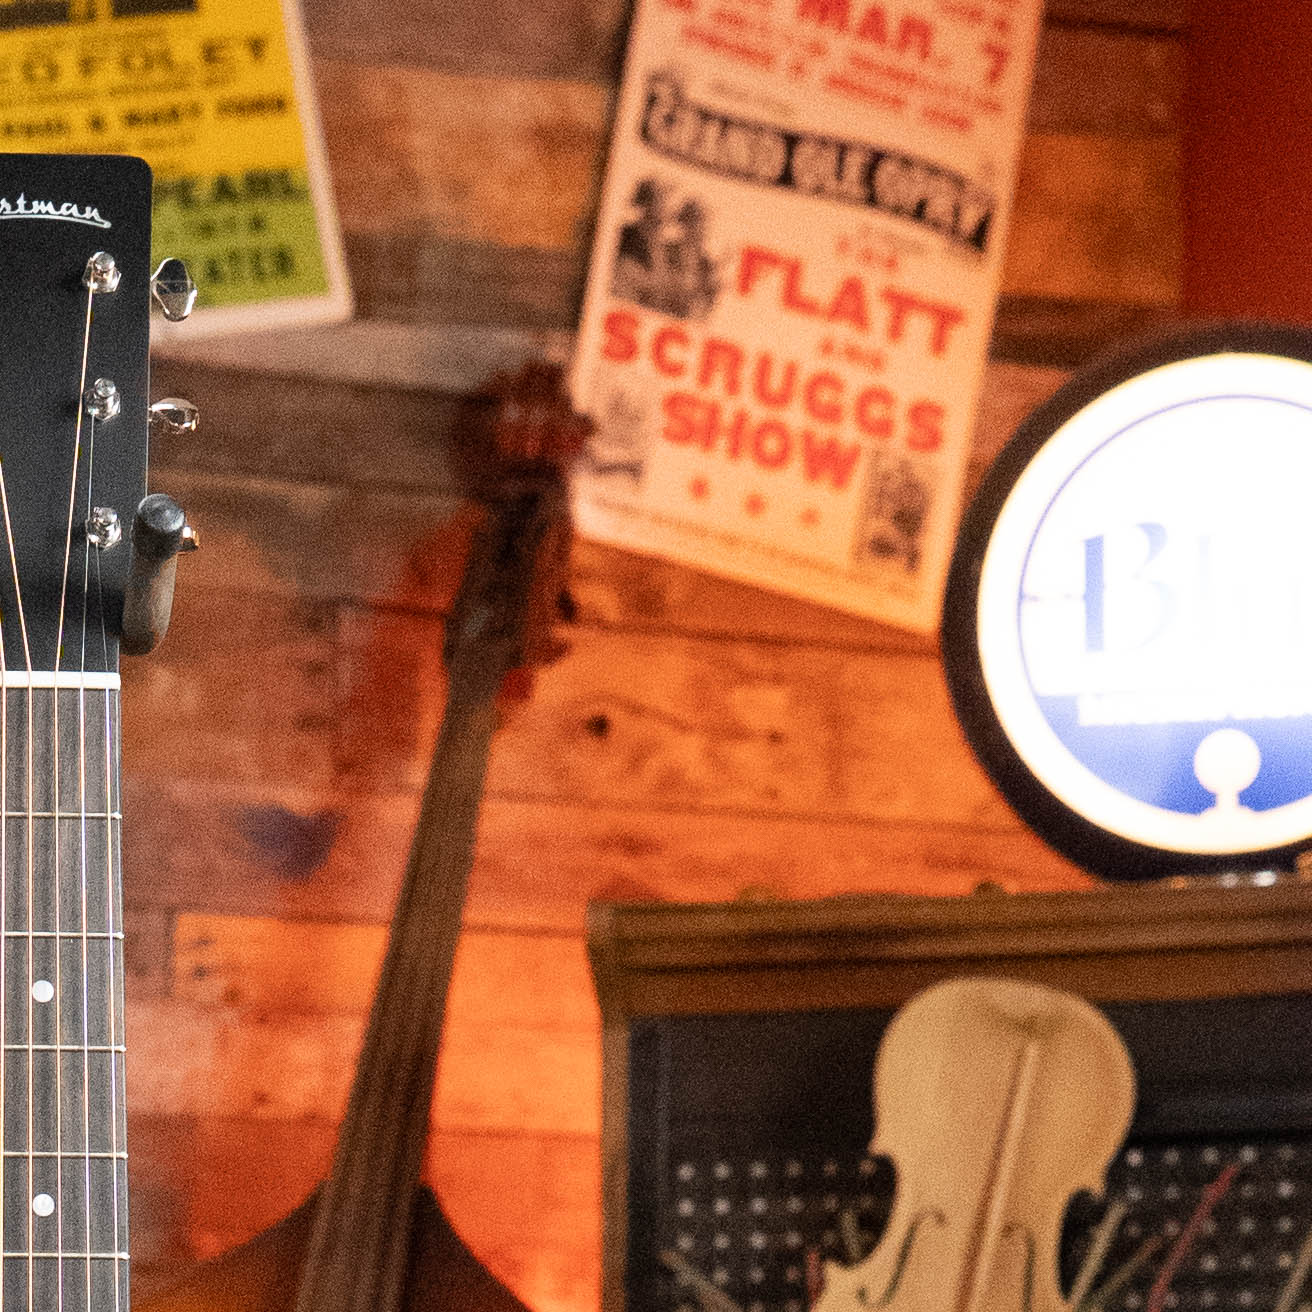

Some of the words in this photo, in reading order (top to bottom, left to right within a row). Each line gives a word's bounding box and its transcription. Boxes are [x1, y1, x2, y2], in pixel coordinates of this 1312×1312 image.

[737, 245, 967, 358] FLATT
[602, 308, 946, 455] SCRUGGS
[661, 390, 862, 491] SHOW
